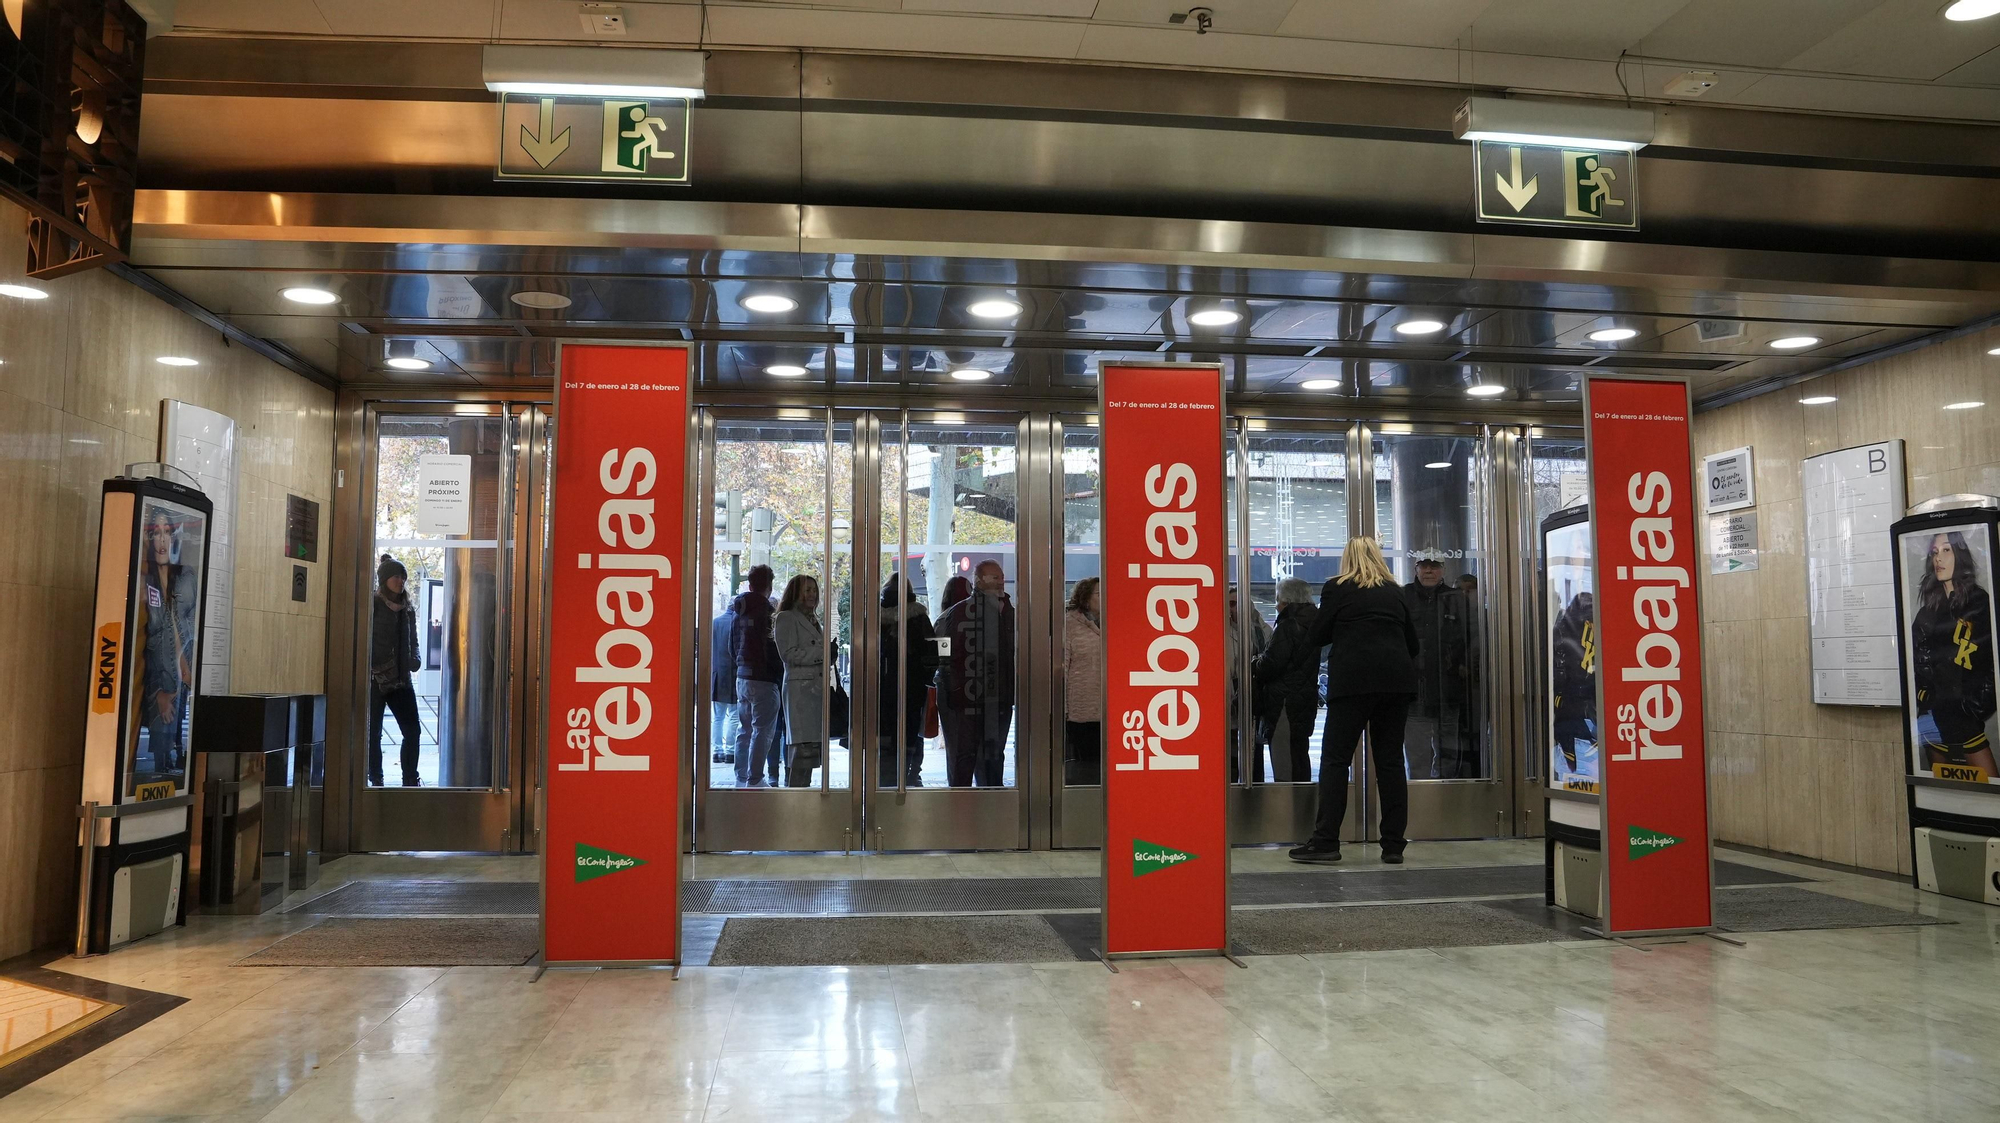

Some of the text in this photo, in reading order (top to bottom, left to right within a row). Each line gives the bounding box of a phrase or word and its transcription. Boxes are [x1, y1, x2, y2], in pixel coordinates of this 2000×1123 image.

[640, 383, 651, 391] de
[196, 446, 202, 455] 6
[1868, 449, 1887, 474] B
[1720, 524, 1746, 533] COMERCIAL
[1722, 517, 1743, 526] HORARIO
[1723, 535, 1744, 544] ABIERTO
[575, 447, 672, 771] rebajas
[1129, 462, 1215, 771] rebajas
[1616, 471, 1690, 760] rebajas
[97, 636, 117, 700] DKNY
[559, 708, 591, 771] Las
[1611, 703, 1637, 761] Las
[1115, 709, 1145, 771] Las
[1940, 767, 1980, 782] DKNY
[1568, 777, 1594, 792] DKNY
[142, 784, 170, 801] DKNY
[1630, 835, 1675, 848] El Corte Inglés
[577, 855, 635, 869] El Corte Inglés
[1134, 850, 1187, 864] El Corte Inglés
